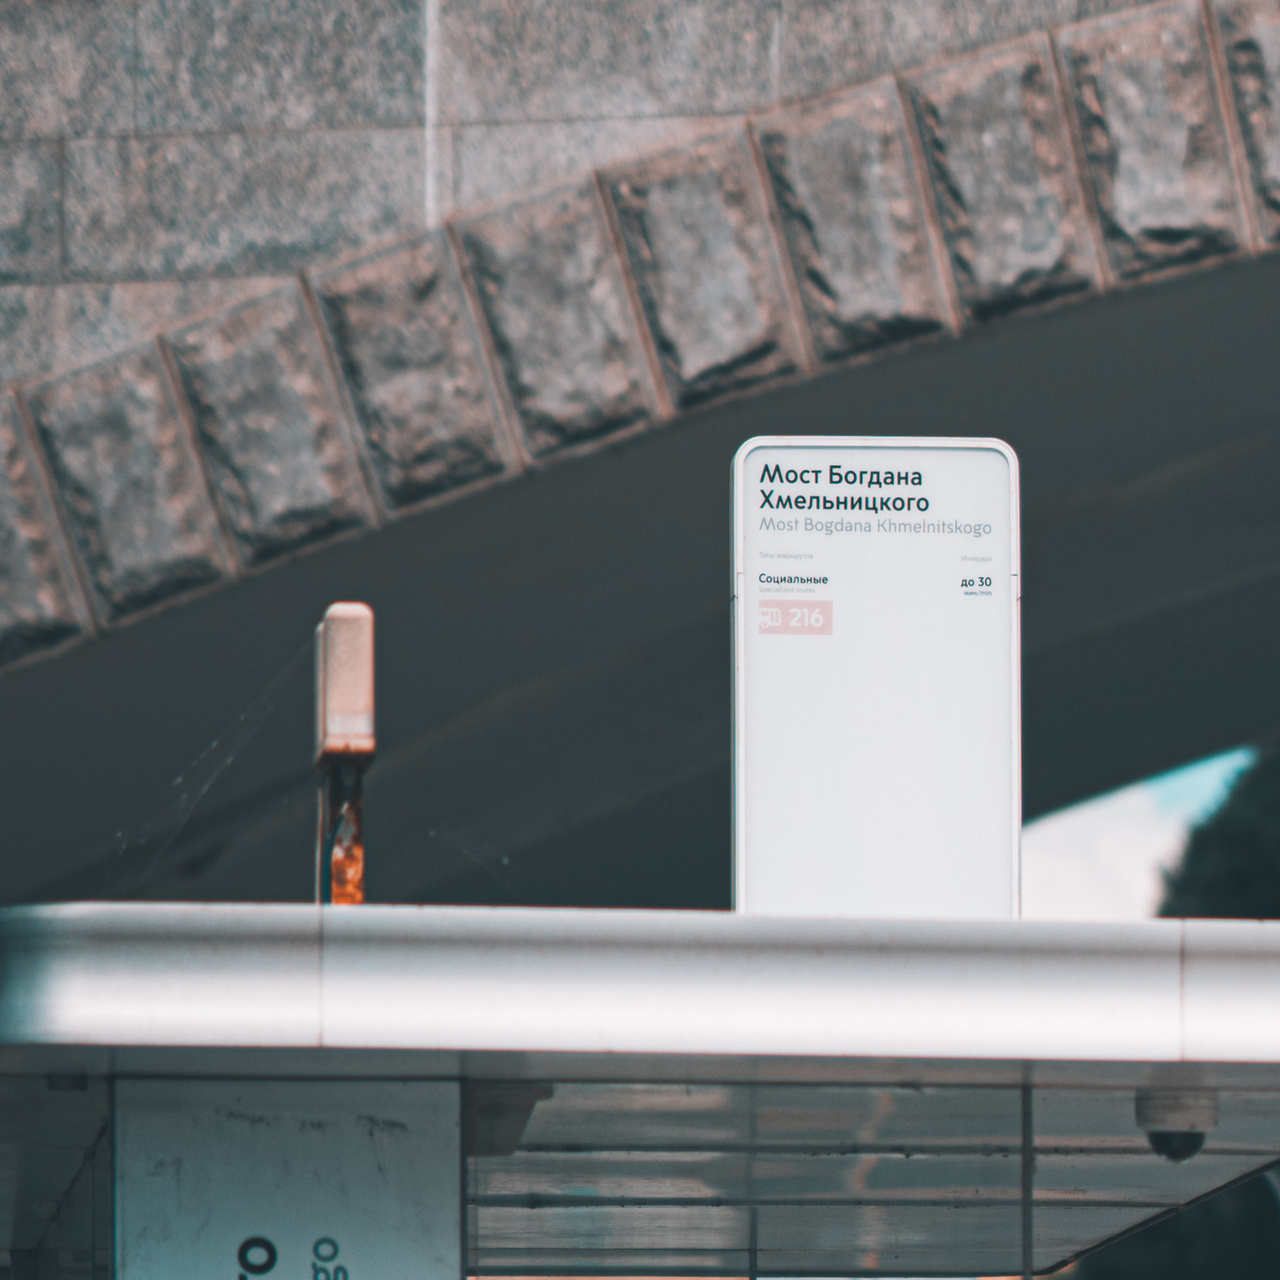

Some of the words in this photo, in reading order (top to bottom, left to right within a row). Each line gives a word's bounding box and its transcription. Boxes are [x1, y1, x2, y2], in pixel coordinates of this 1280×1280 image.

[759, 464, 822, 484] Мост
[829, 465, 923, 488] Богдана
[759, 489, 930, 513] Хмельницкого
[759, 517, 800, 532] Most
[804, 517, 872, 535] Bogdana
[877, 519, 992, 538] Khmelnitskogo
[758, 573, 829, 585] Социальные
[960, 578, 975, 588] до
[978, 576, 992, 587] 30
[789, 607, 824, 628] 216
